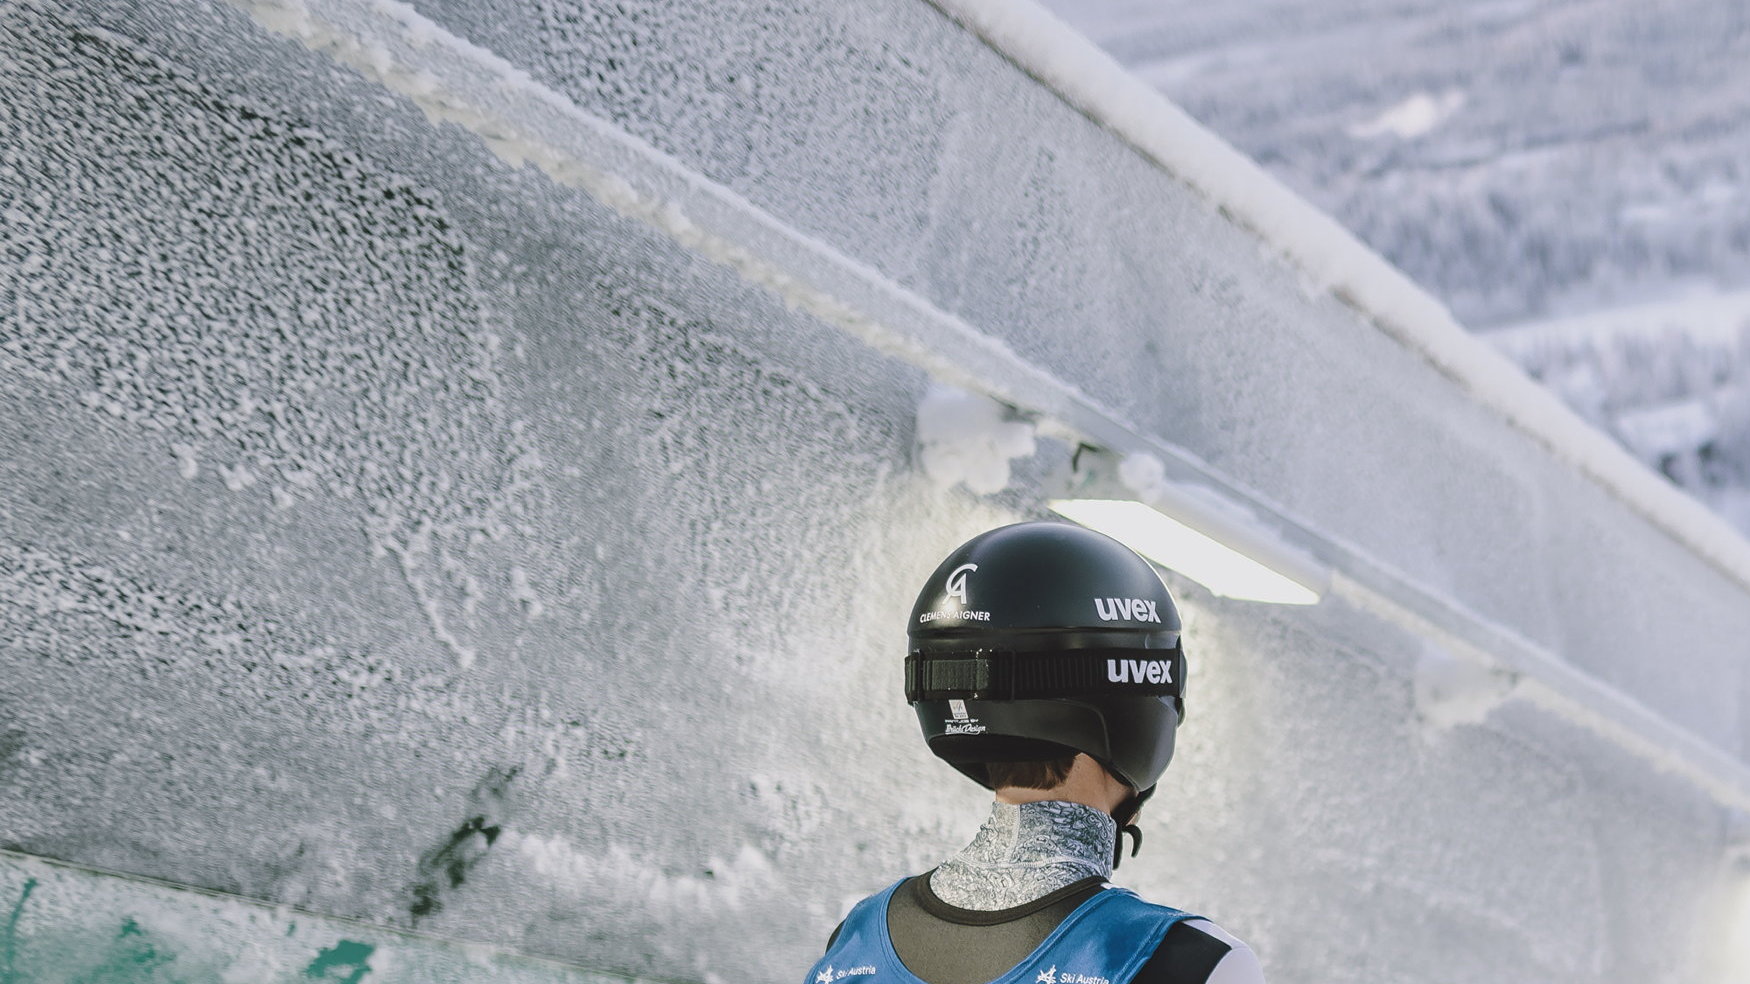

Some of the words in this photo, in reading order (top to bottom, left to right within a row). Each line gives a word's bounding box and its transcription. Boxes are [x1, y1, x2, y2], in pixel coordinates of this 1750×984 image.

[919, 611, 951, 624] CLEMENS
[953, 610, 991, 622] AIGNER
[1094, 597, 1162, 624] uvex
[1107, 659, 1173, 684] uvex
[848, 965, 876, 976] Austria
[1060, 972, 1076, 984] Ski
